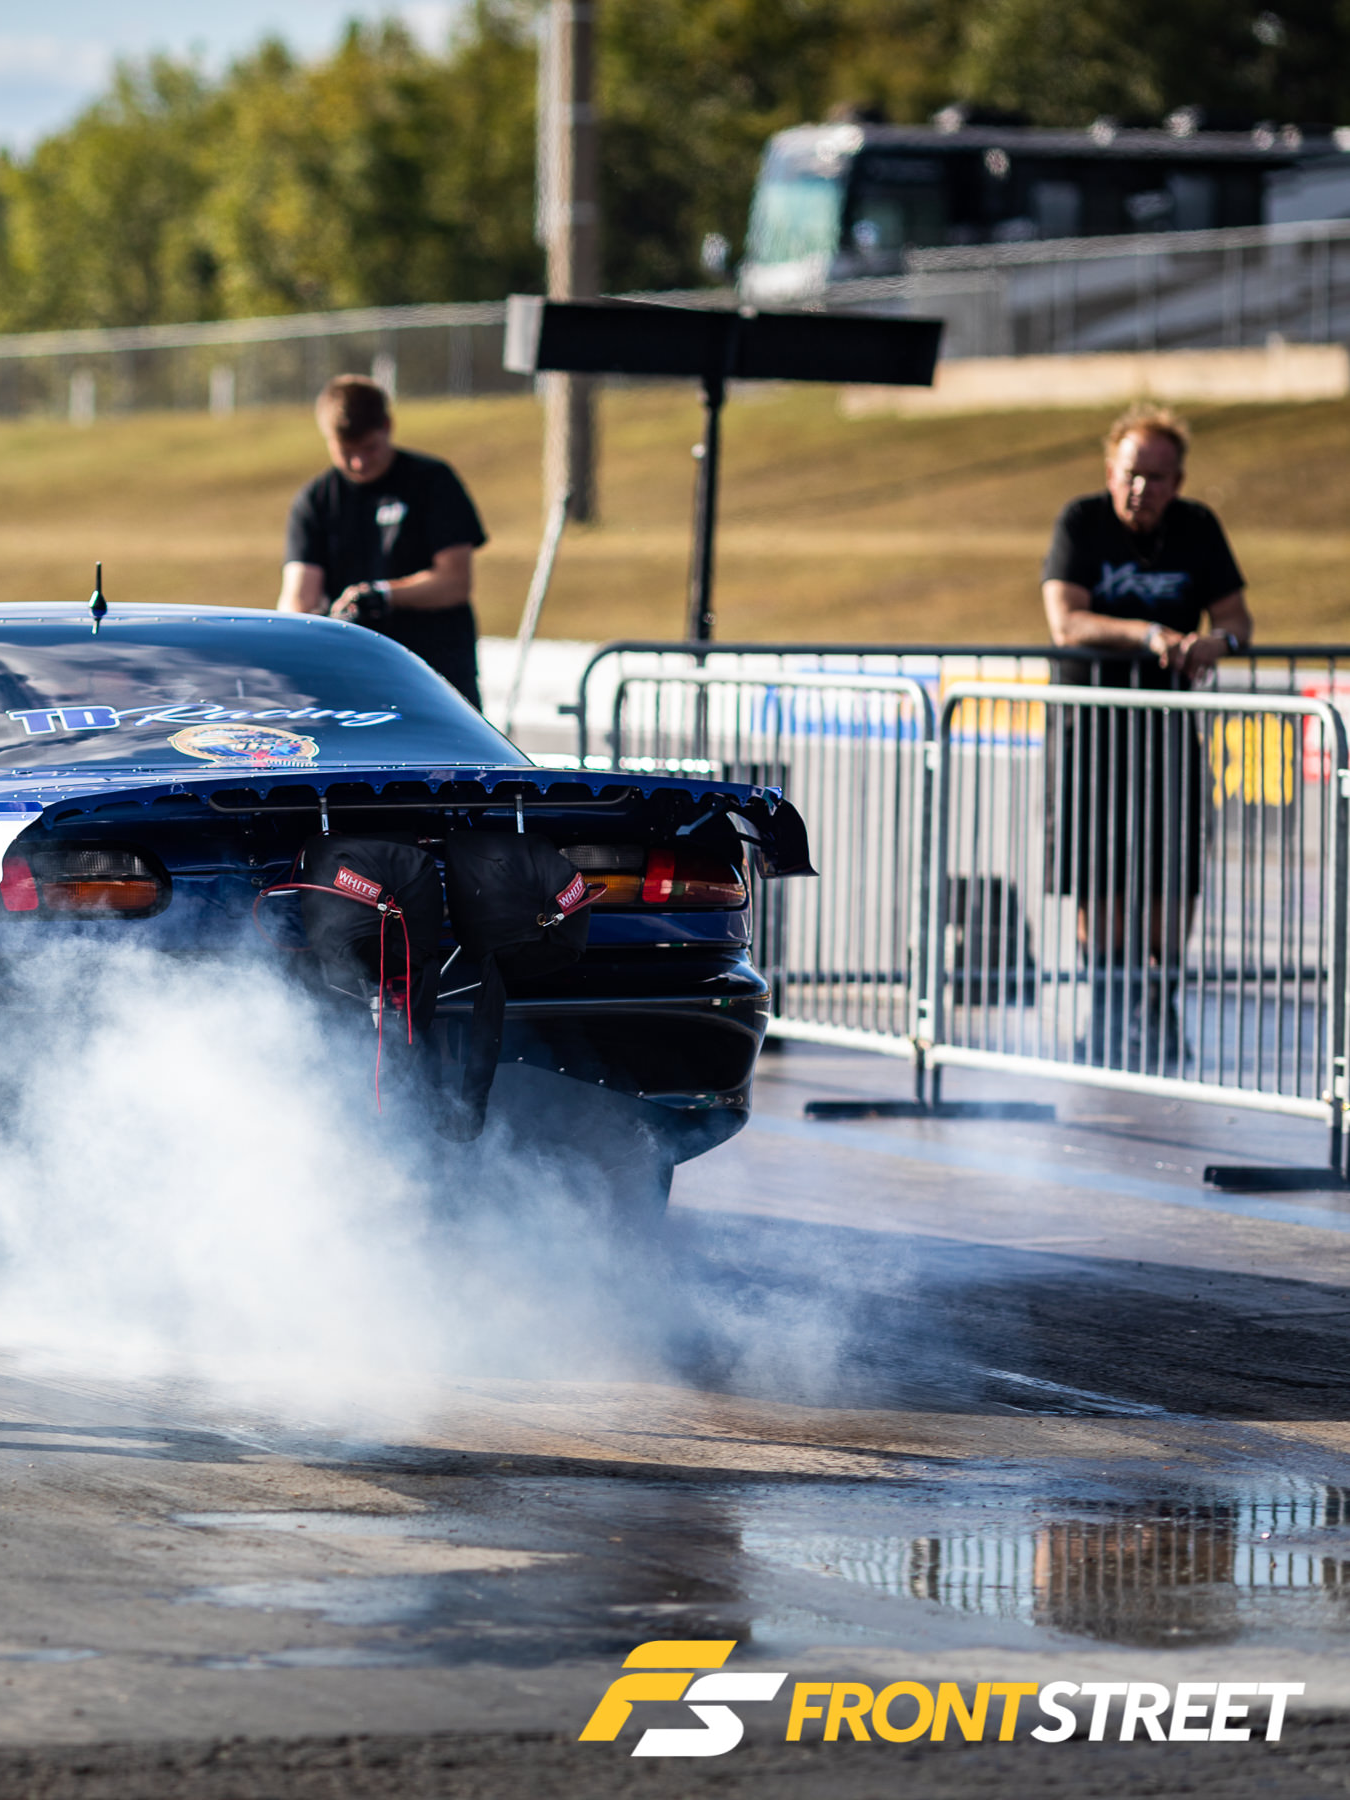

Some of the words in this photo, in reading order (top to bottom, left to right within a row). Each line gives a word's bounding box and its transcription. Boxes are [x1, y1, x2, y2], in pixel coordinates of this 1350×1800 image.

[9, 704, 122, 735] TD
[109, 703, 403, 726] Racing
[339, 870, 379, 898] WHITE
